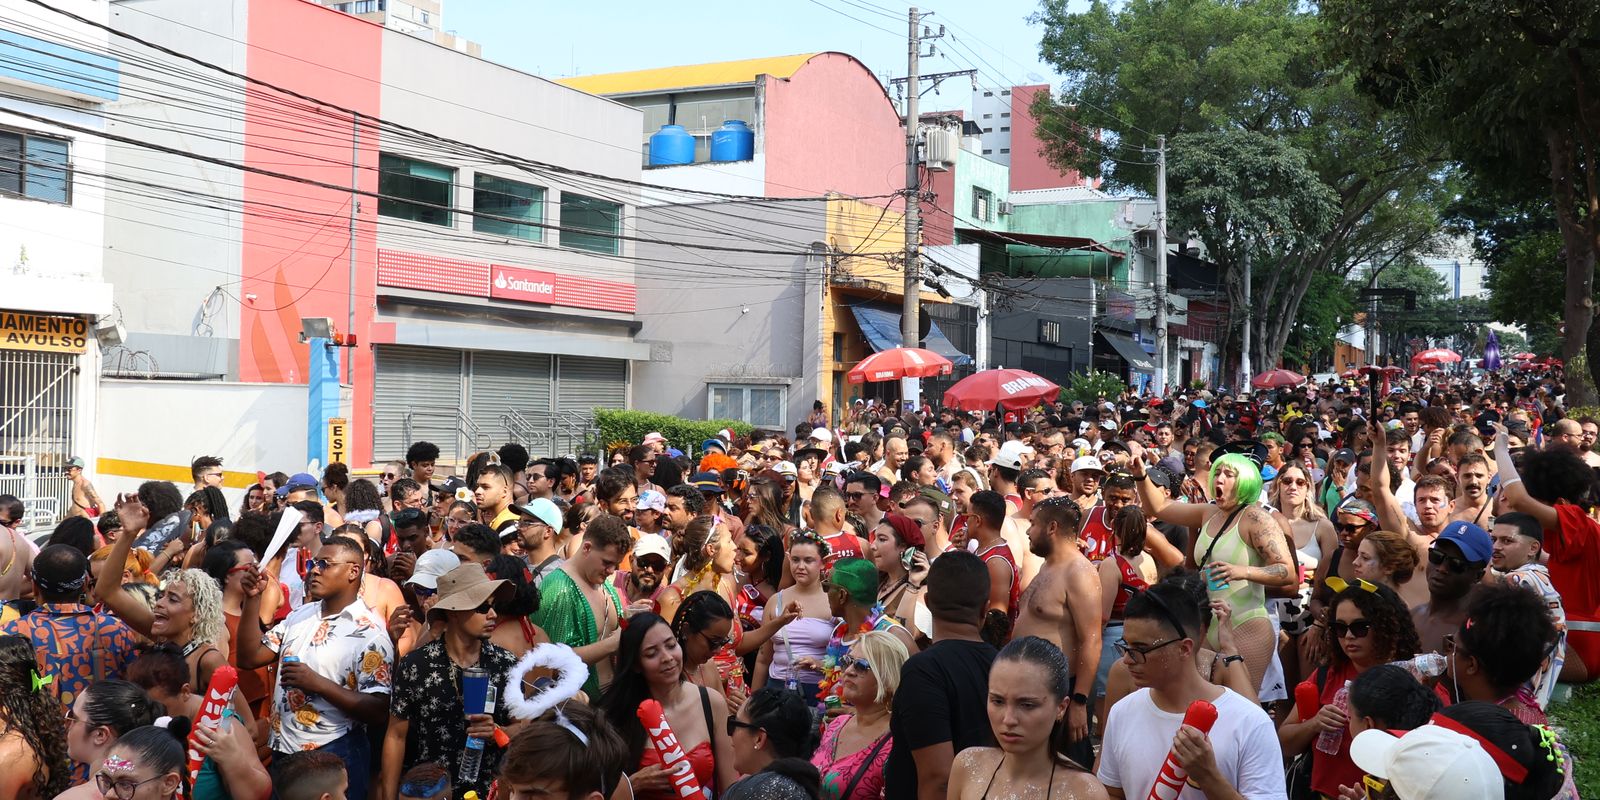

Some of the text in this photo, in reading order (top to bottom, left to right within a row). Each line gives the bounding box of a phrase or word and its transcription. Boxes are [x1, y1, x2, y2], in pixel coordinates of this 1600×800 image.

[507, 276, 554, 295] Santander
[0, 313, 86, 336] AMENTO
[7, 332, 86, 348] AVULSO
[837, 549, 854, 558] 2025
